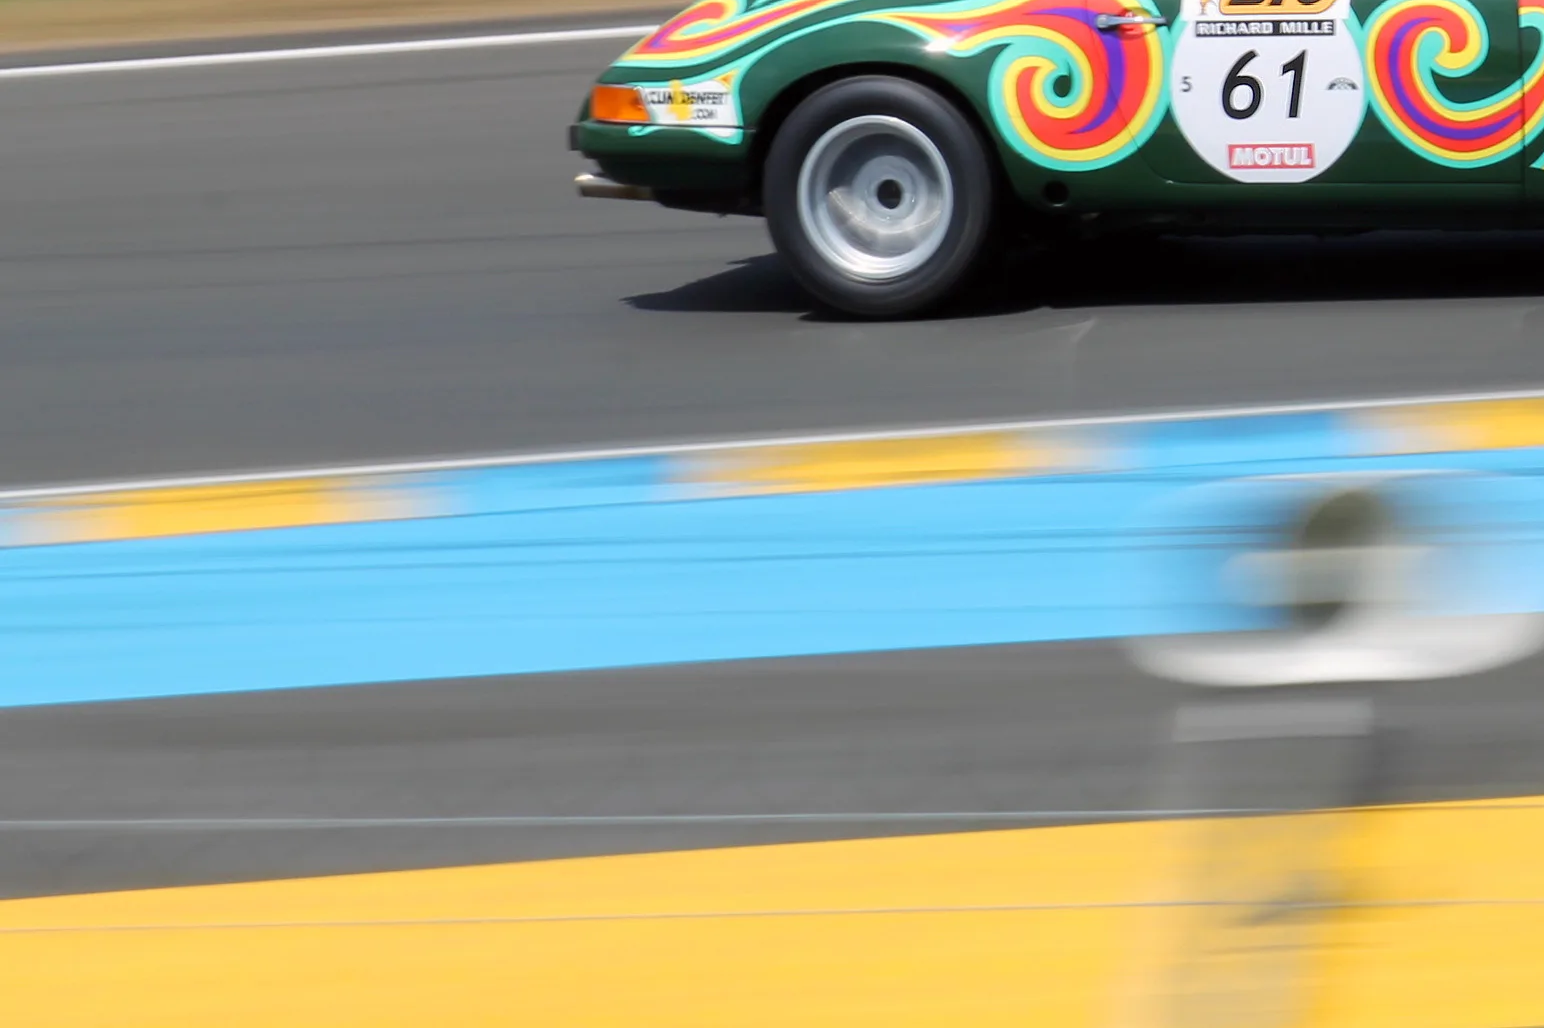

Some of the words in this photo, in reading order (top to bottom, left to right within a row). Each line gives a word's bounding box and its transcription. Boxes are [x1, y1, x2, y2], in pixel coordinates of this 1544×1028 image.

[1196, 22, 1274, 35] RICHARD
[1279, 21, 1334, 34] MILLE
[1180, 76, 1193, 93] 5
[1221, 49, 1309, 120] 61
[1231, 146, 1313, 167] MOTUL
